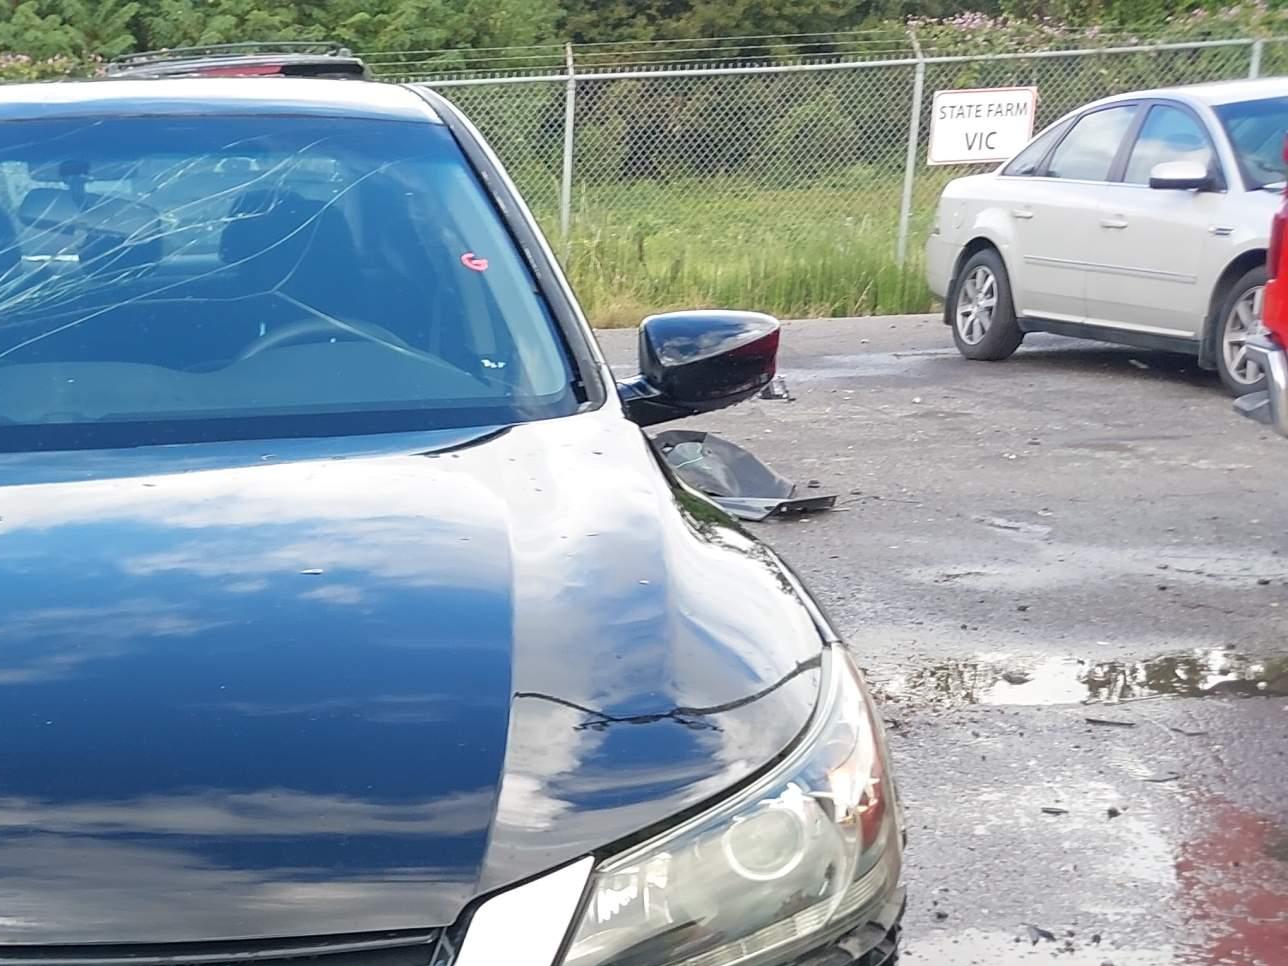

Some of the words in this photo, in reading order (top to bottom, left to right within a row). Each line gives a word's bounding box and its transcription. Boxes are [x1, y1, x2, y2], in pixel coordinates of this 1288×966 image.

[939, 104, 983, 120] STATE
[986, 102, 1028, 118] FARM
[965, 131, 998, 151] VIC
